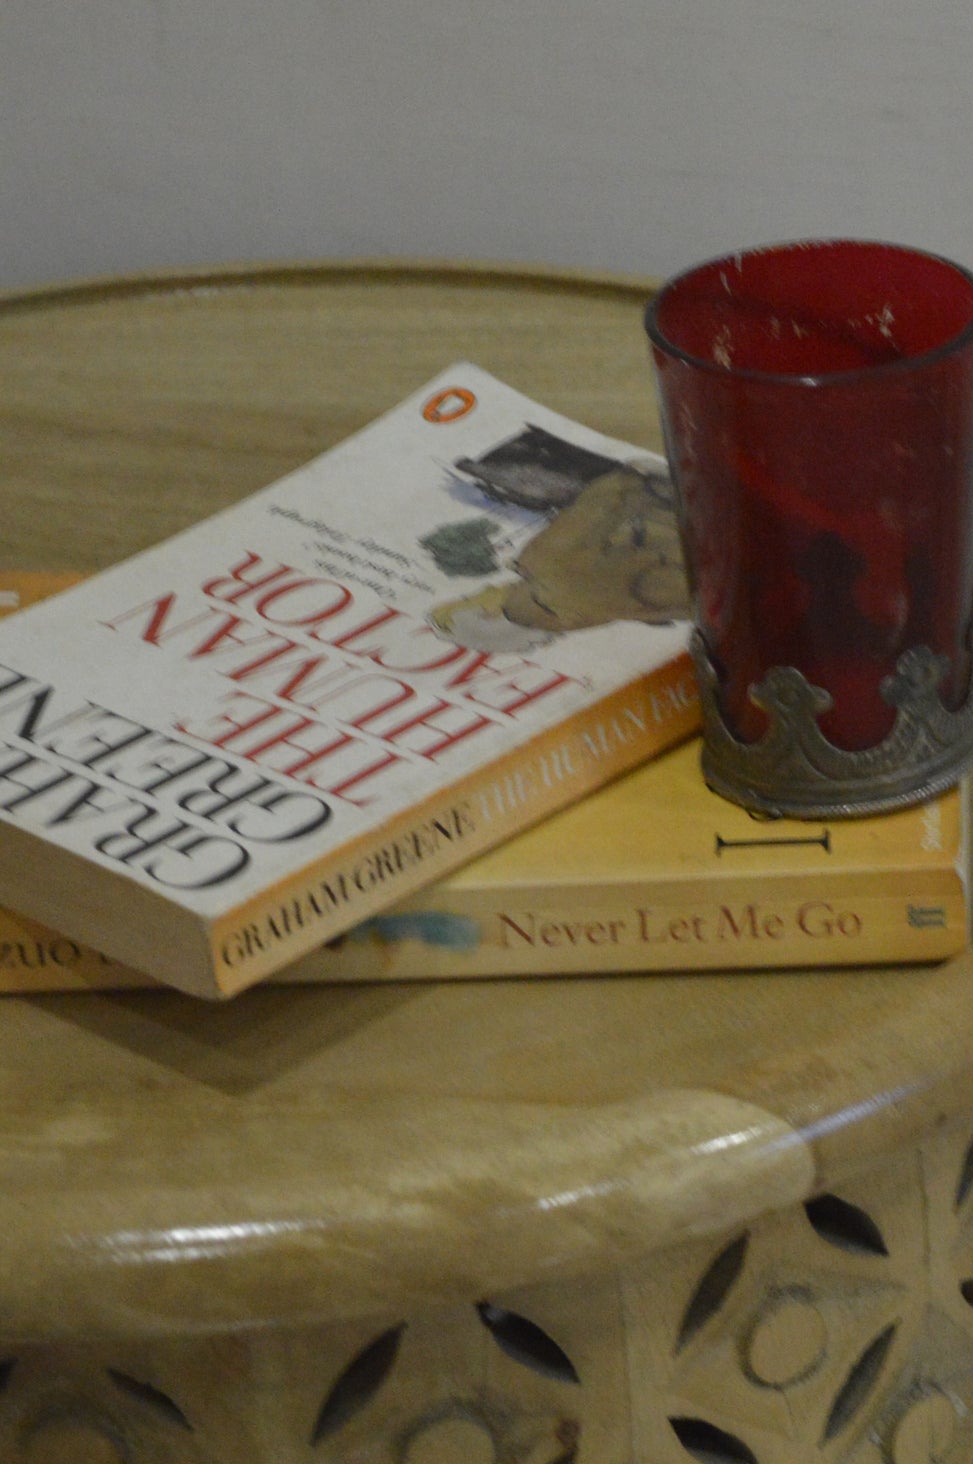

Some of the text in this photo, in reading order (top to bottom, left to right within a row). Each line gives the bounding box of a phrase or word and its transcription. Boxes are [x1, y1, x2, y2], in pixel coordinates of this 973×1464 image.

[97, 591, 502, 764] HUMAN
[202, 550, 585, 719] FACTOR
[0, 738, 250, 890] GRAH
[172, 690, 382, 808] THE
[221, 873, 349, 968] GRAHAM
[350, 800, 477, 893] GREENE
[499, 899, 863, 949] Never Let Me Go
